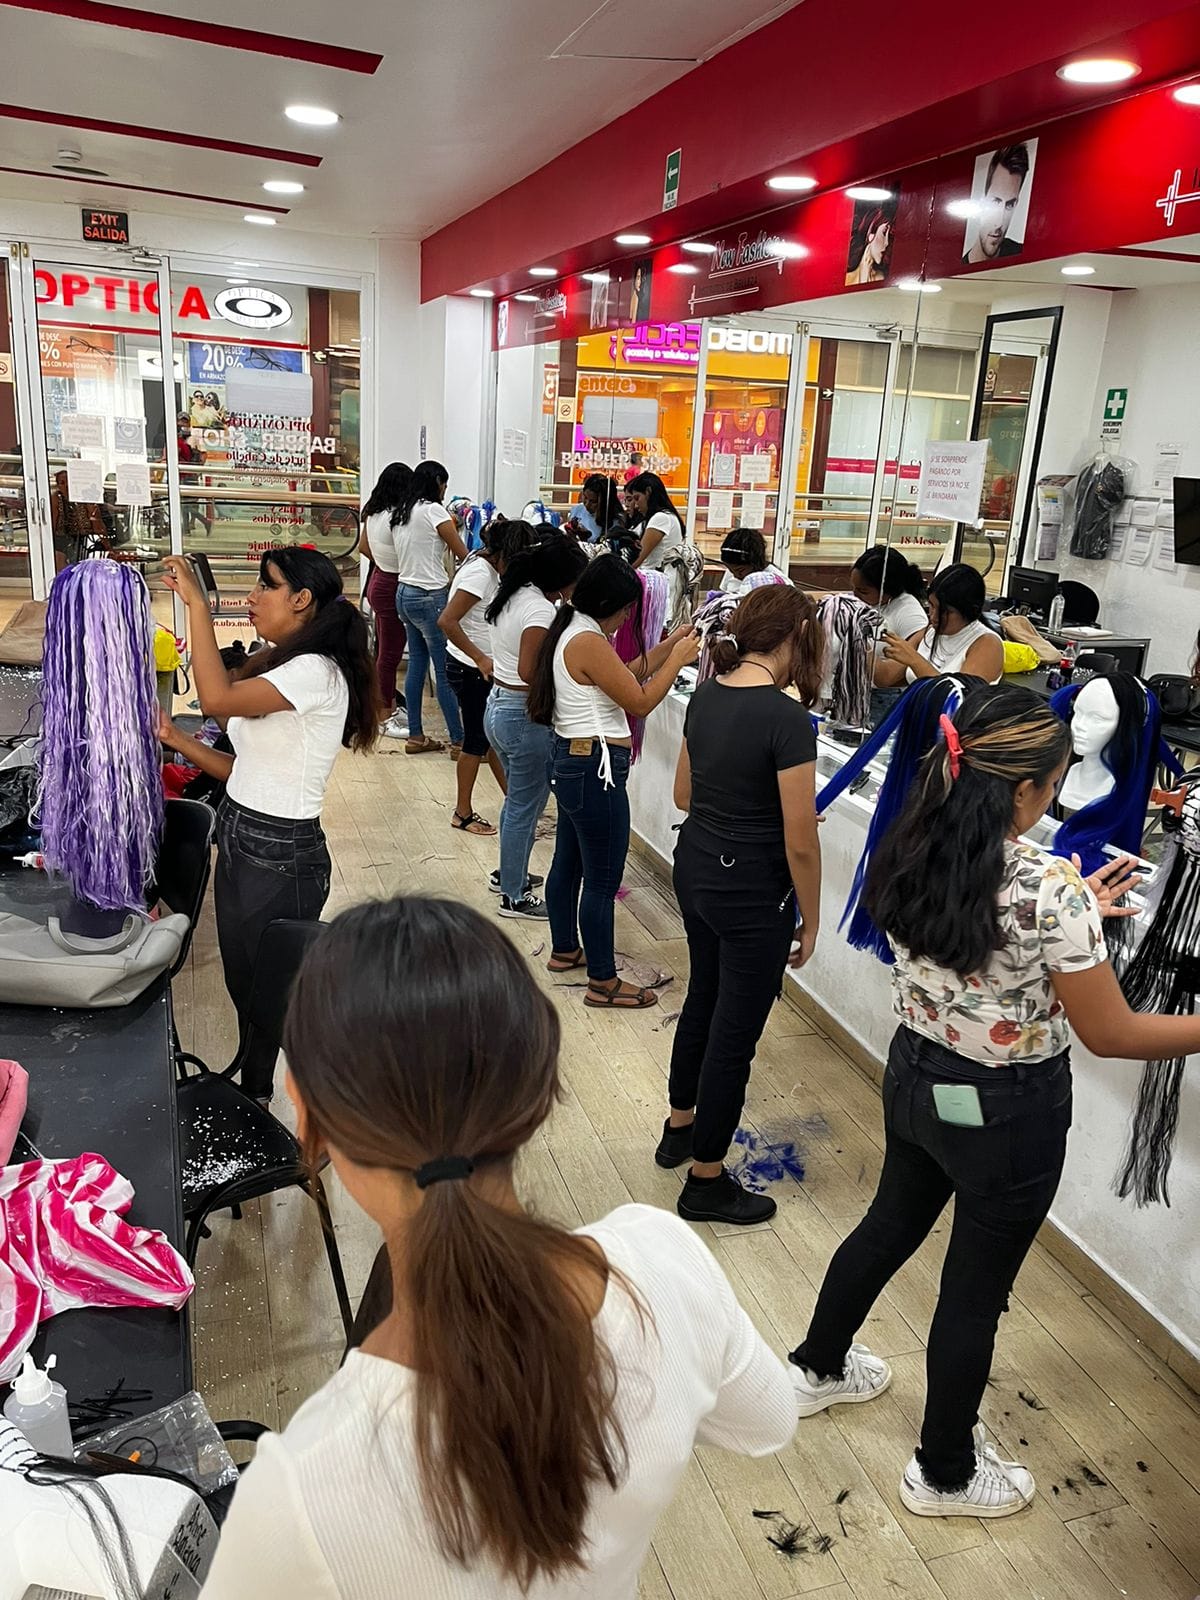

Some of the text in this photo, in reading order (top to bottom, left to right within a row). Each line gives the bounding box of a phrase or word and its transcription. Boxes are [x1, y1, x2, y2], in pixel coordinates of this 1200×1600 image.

[91, 212, 119, 227] EXIT
[84, 226, 127, 241] SALIDA
[34, 269, 211, 322] OPTICA
[202, 344, 225, 373] 20
[641, 456, 682, 472] SHOP
[941, 455, 968, 464] SORPRENDE
[900, 536, 942, 546] 18 Meses
